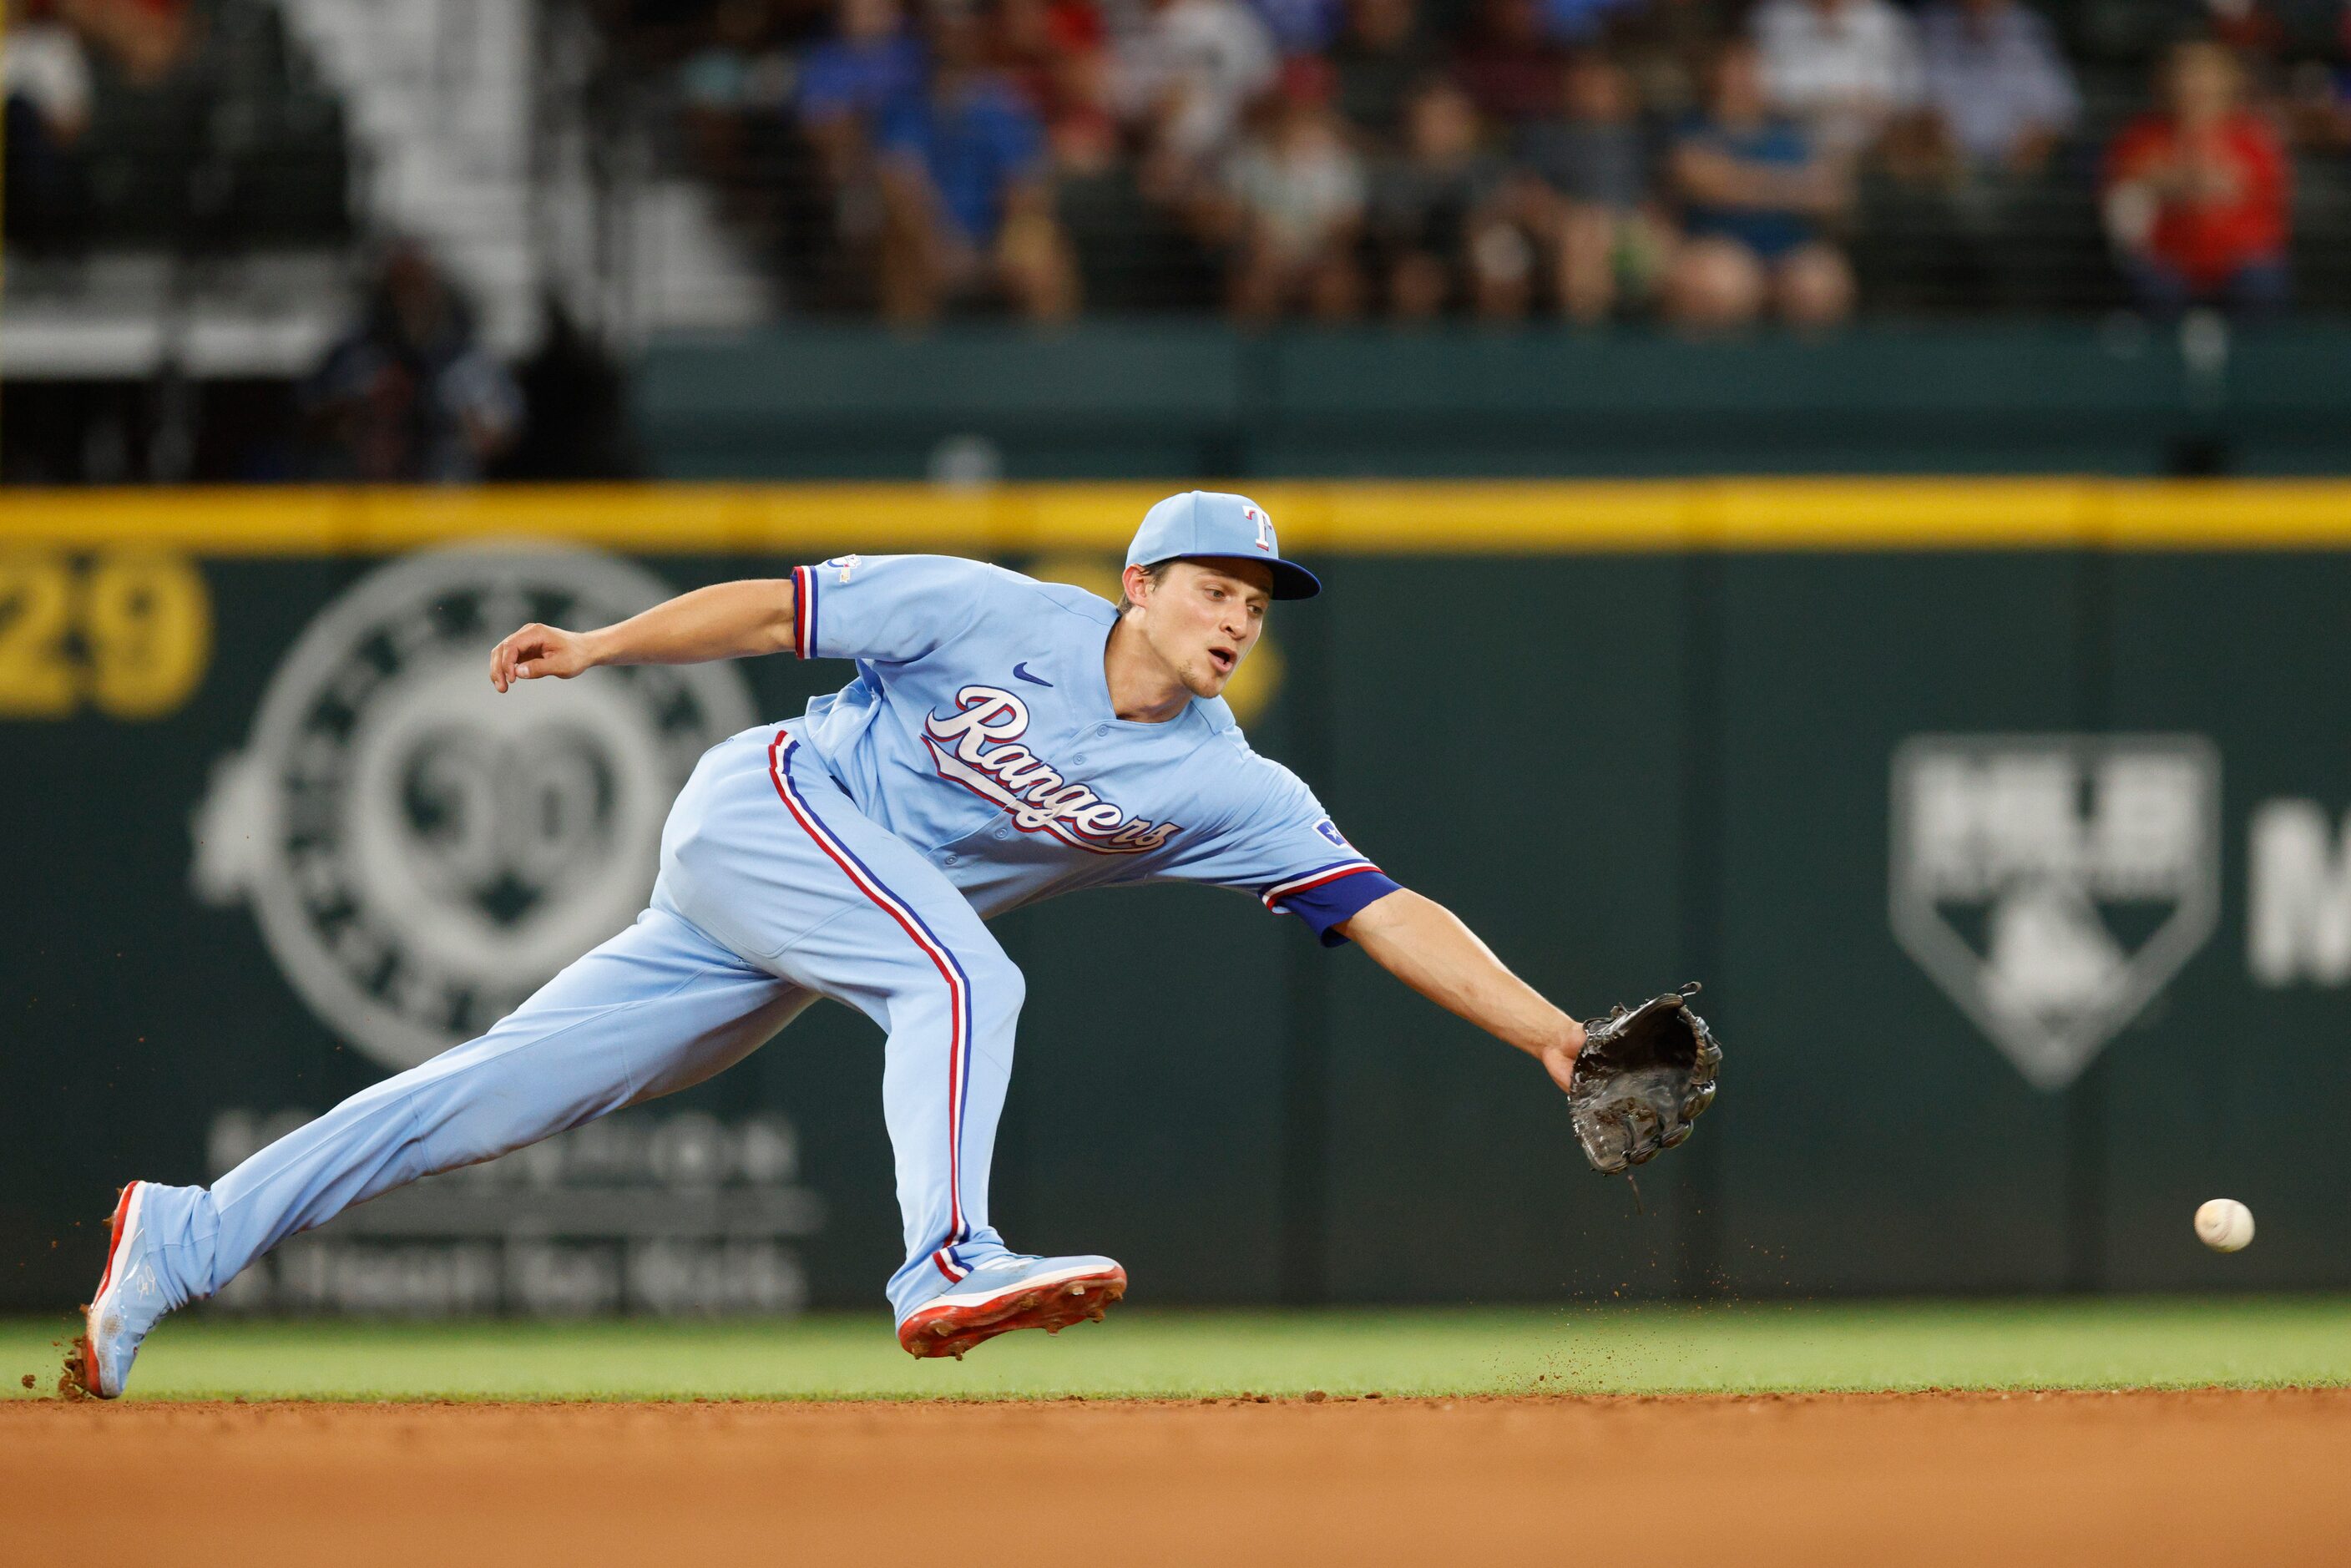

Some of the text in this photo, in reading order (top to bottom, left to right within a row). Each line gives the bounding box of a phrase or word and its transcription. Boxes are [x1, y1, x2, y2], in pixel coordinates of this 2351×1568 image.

[1241, 505, 1272, 552] T
[0, 549, 212, 715] 29
[921, 685, 1184, 854] Rangers
